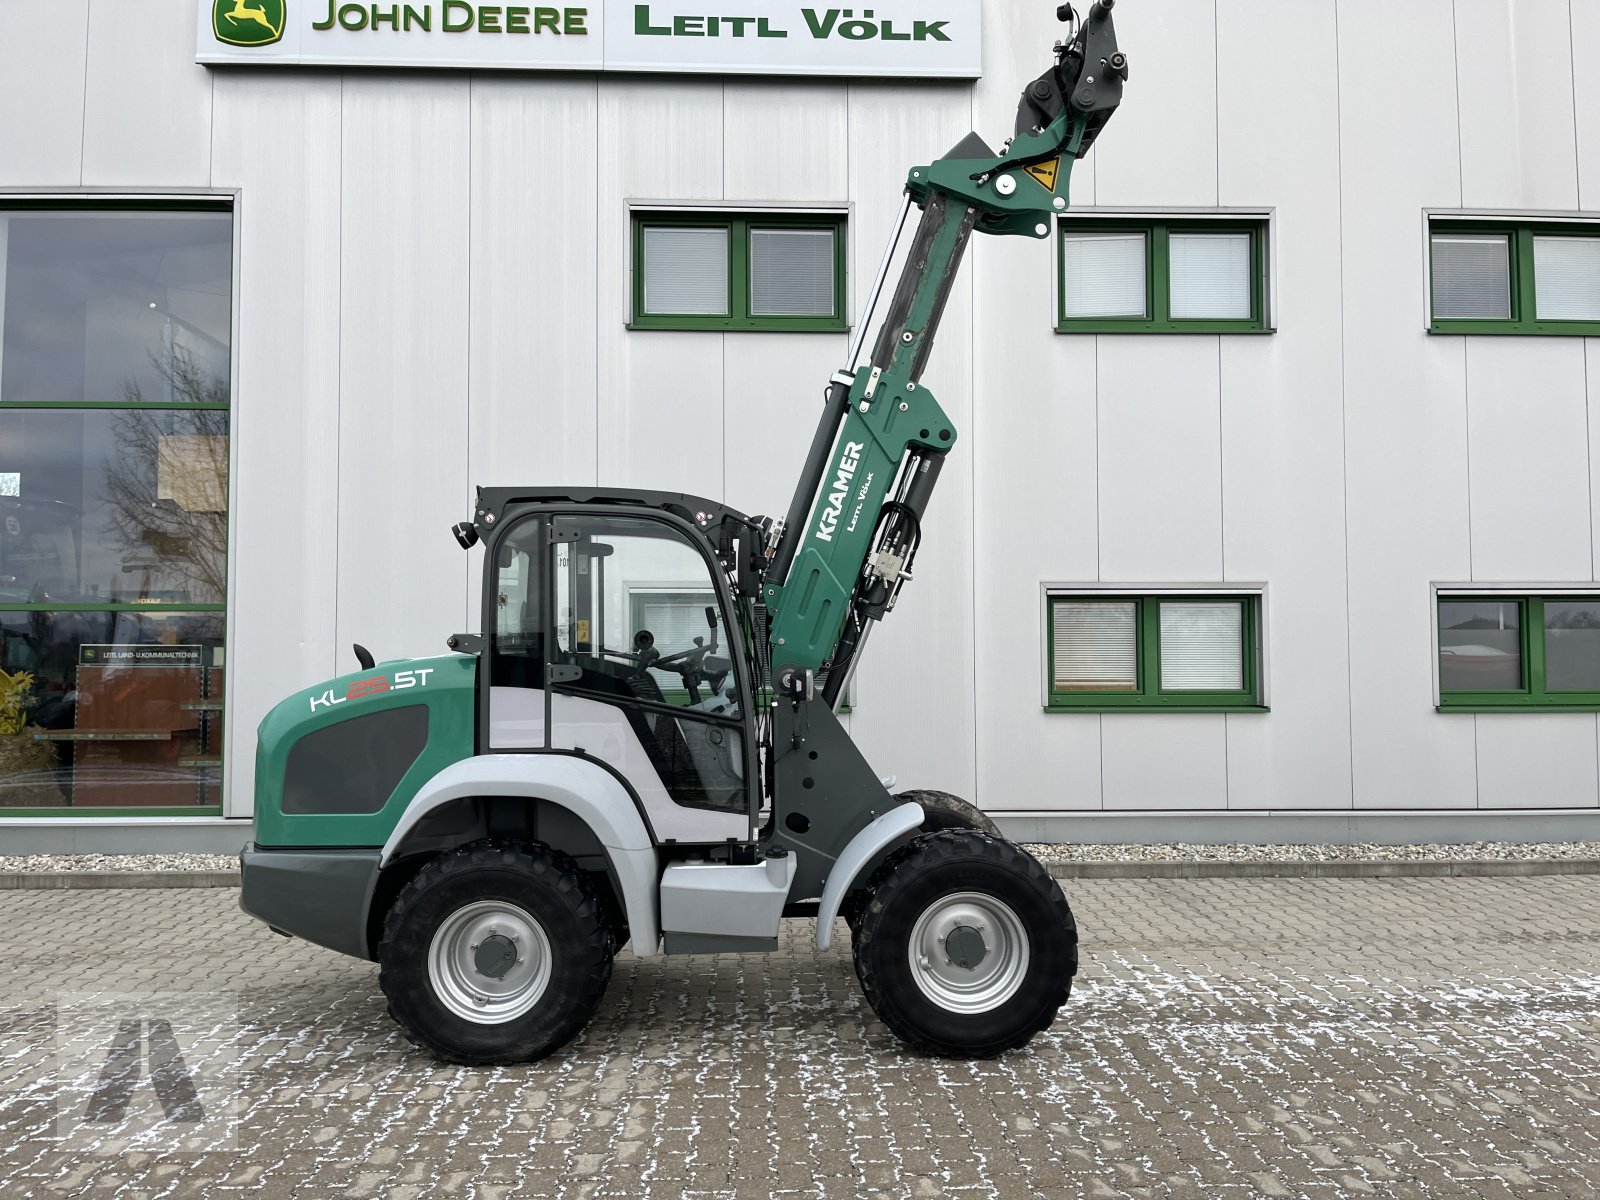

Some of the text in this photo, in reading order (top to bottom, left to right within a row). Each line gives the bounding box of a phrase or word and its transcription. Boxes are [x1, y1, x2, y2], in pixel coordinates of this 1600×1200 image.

[312, 0, 588, 35] JOHN DEERE
[634, 4, 953, 42] LEITL VÖLK
[815, 441, 864, 542] KRAMER
[847, 472, 874, 533] LEITL VÖLK
[310, 668, 434, 712] KL25.5T
